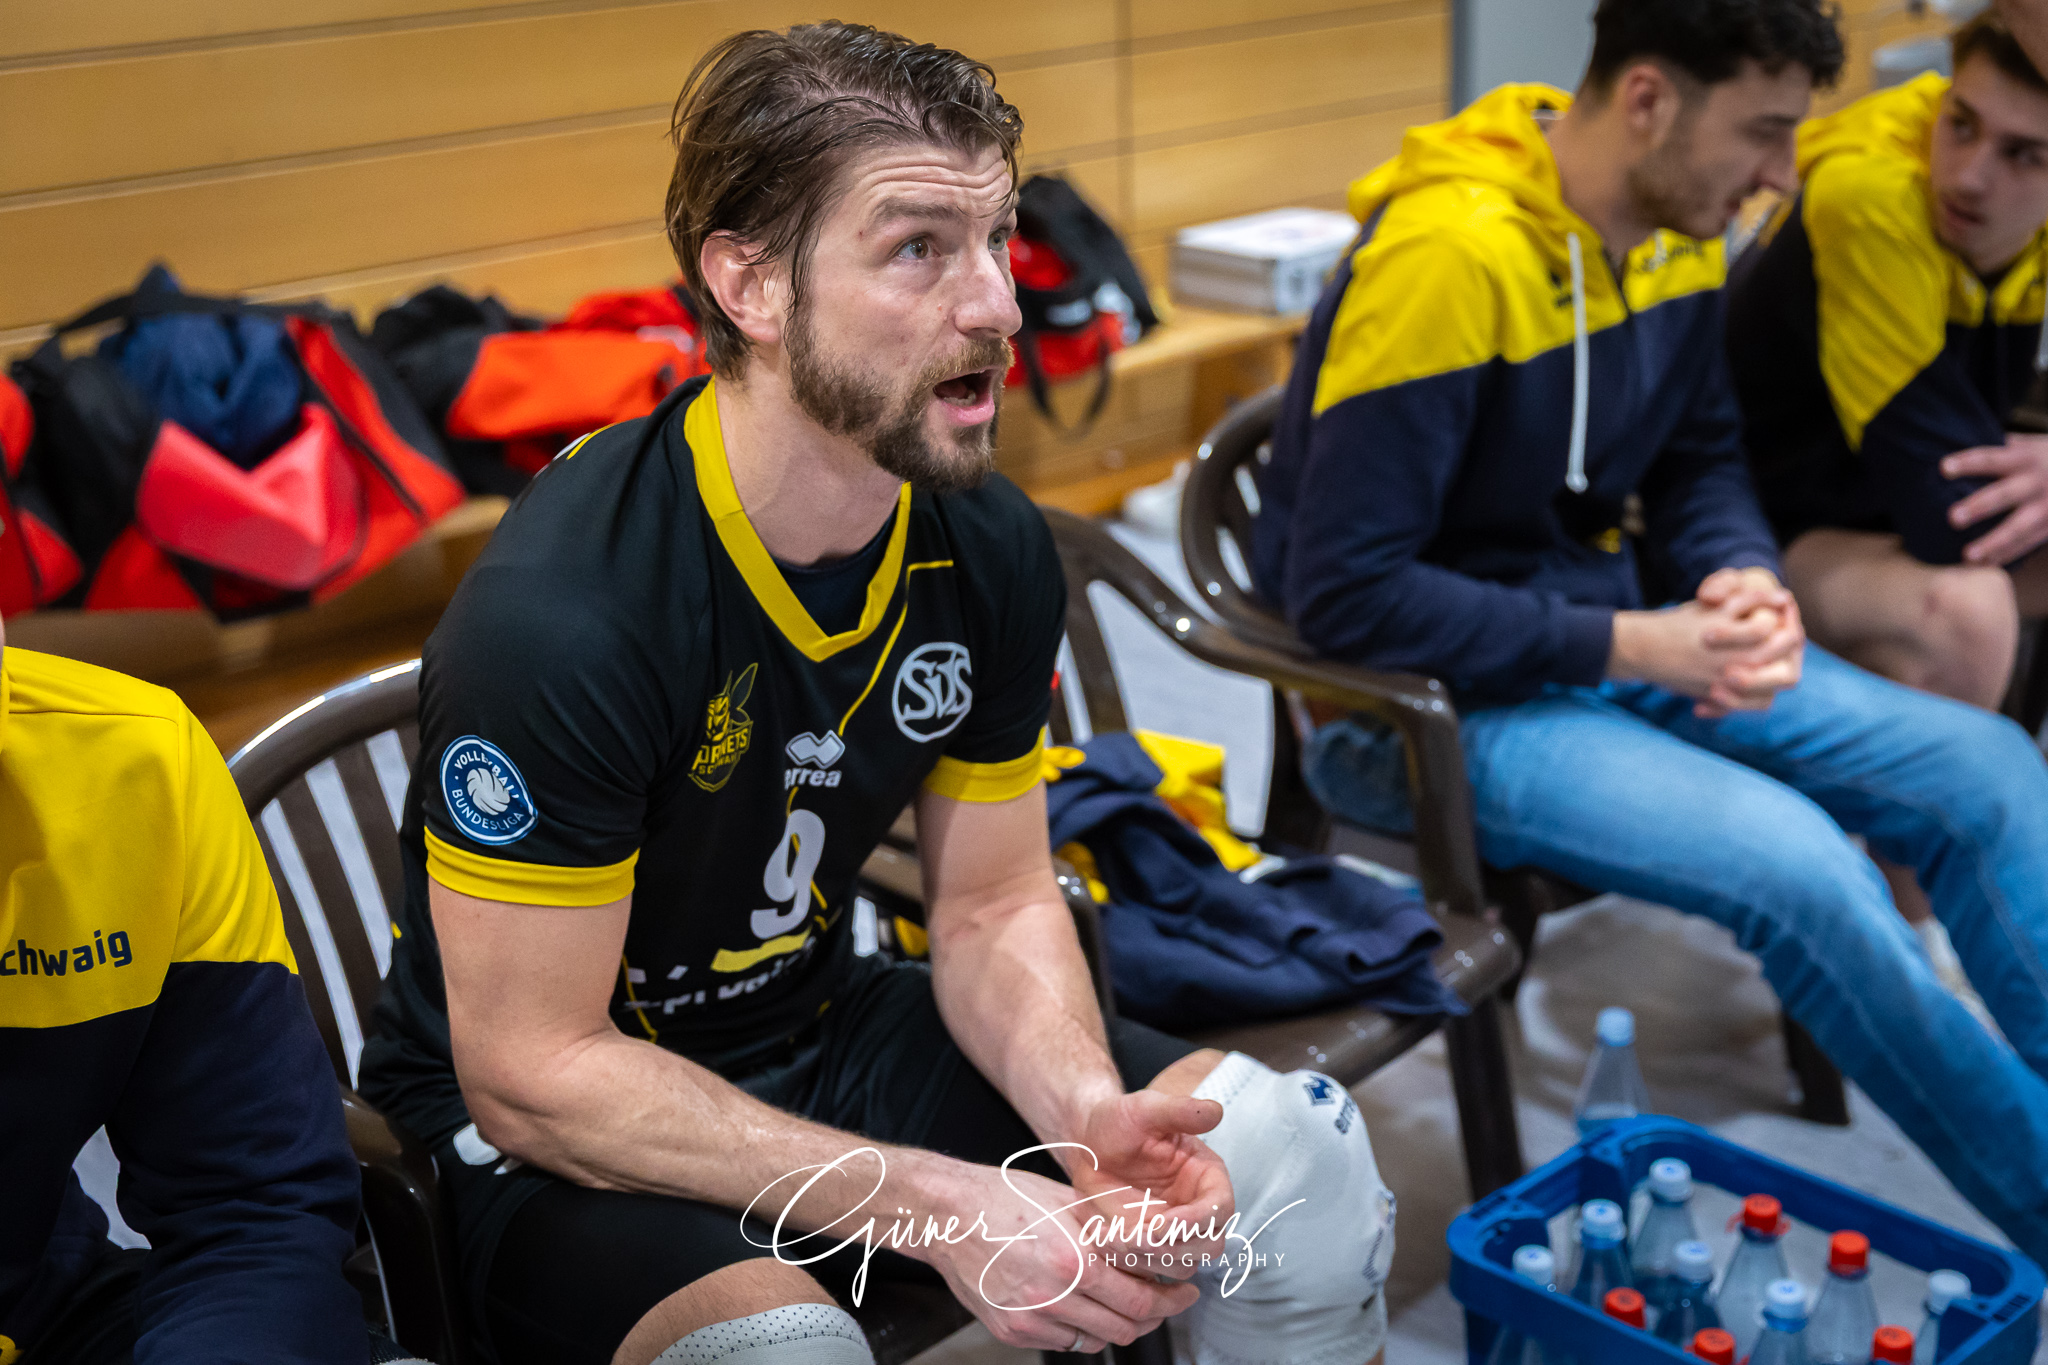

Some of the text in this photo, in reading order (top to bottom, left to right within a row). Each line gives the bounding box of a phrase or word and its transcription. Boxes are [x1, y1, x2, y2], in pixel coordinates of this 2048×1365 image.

[691, 727, 749, 771] ORETS
[452, 788, 524, 831] BUNDESLIGA
[751, 809, 826, 940] 9
